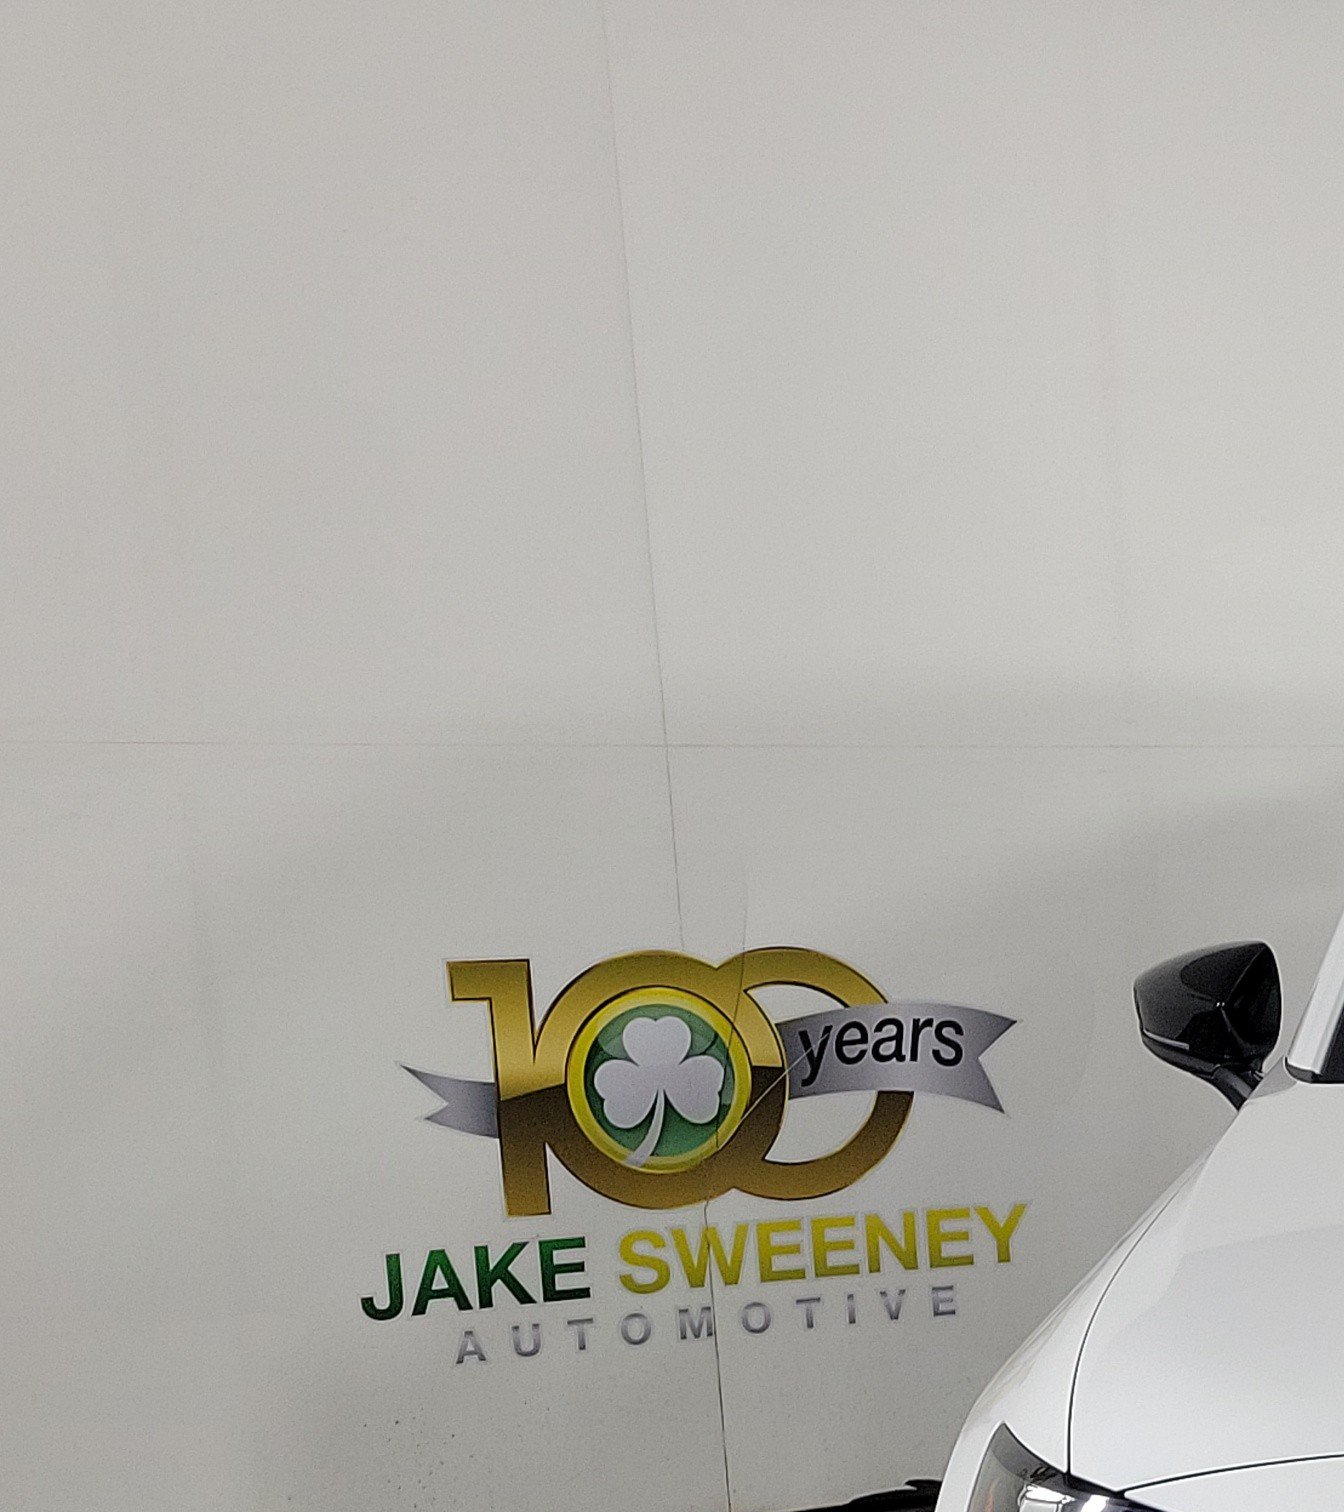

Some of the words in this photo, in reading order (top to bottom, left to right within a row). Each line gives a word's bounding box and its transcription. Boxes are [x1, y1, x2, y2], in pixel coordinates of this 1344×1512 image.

[446, 946, 914, 1216] 100
[798, 1017, 965, 1086] years
[360, 1236, 592, 1320] JAKE
[618, 1203, 1030, 1295] SWEENEY
[456, 1286, 957, 1365] AUTOMOTIVE
